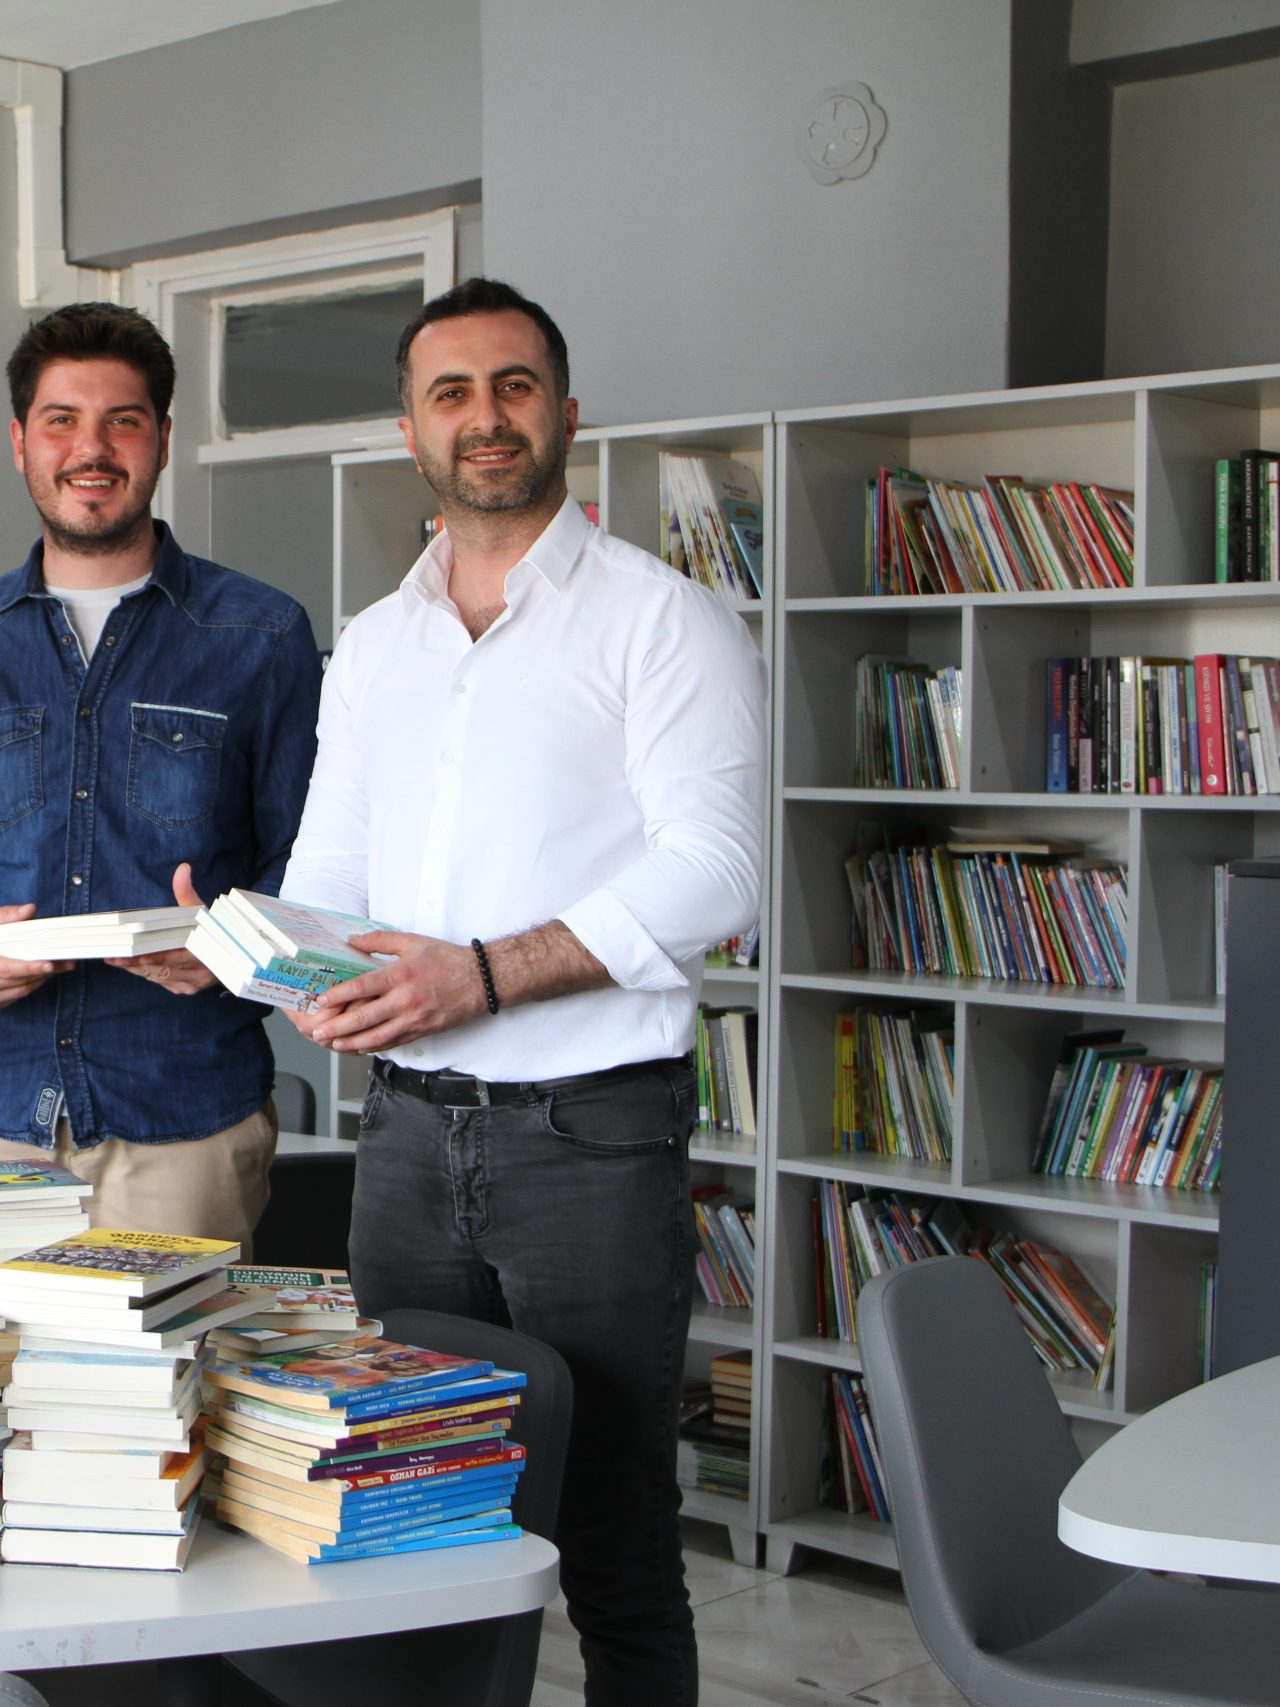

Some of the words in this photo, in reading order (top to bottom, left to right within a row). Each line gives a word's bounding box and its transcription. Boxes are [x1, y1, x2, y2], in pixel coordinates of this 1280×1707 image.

[277, 963, 309, 978] KAYIP
[442, 1418, 454, 1427] Linda
[390, 1469, 415, 1482] OSMAN
[417, 1466, 435, 1478] GAZİ
